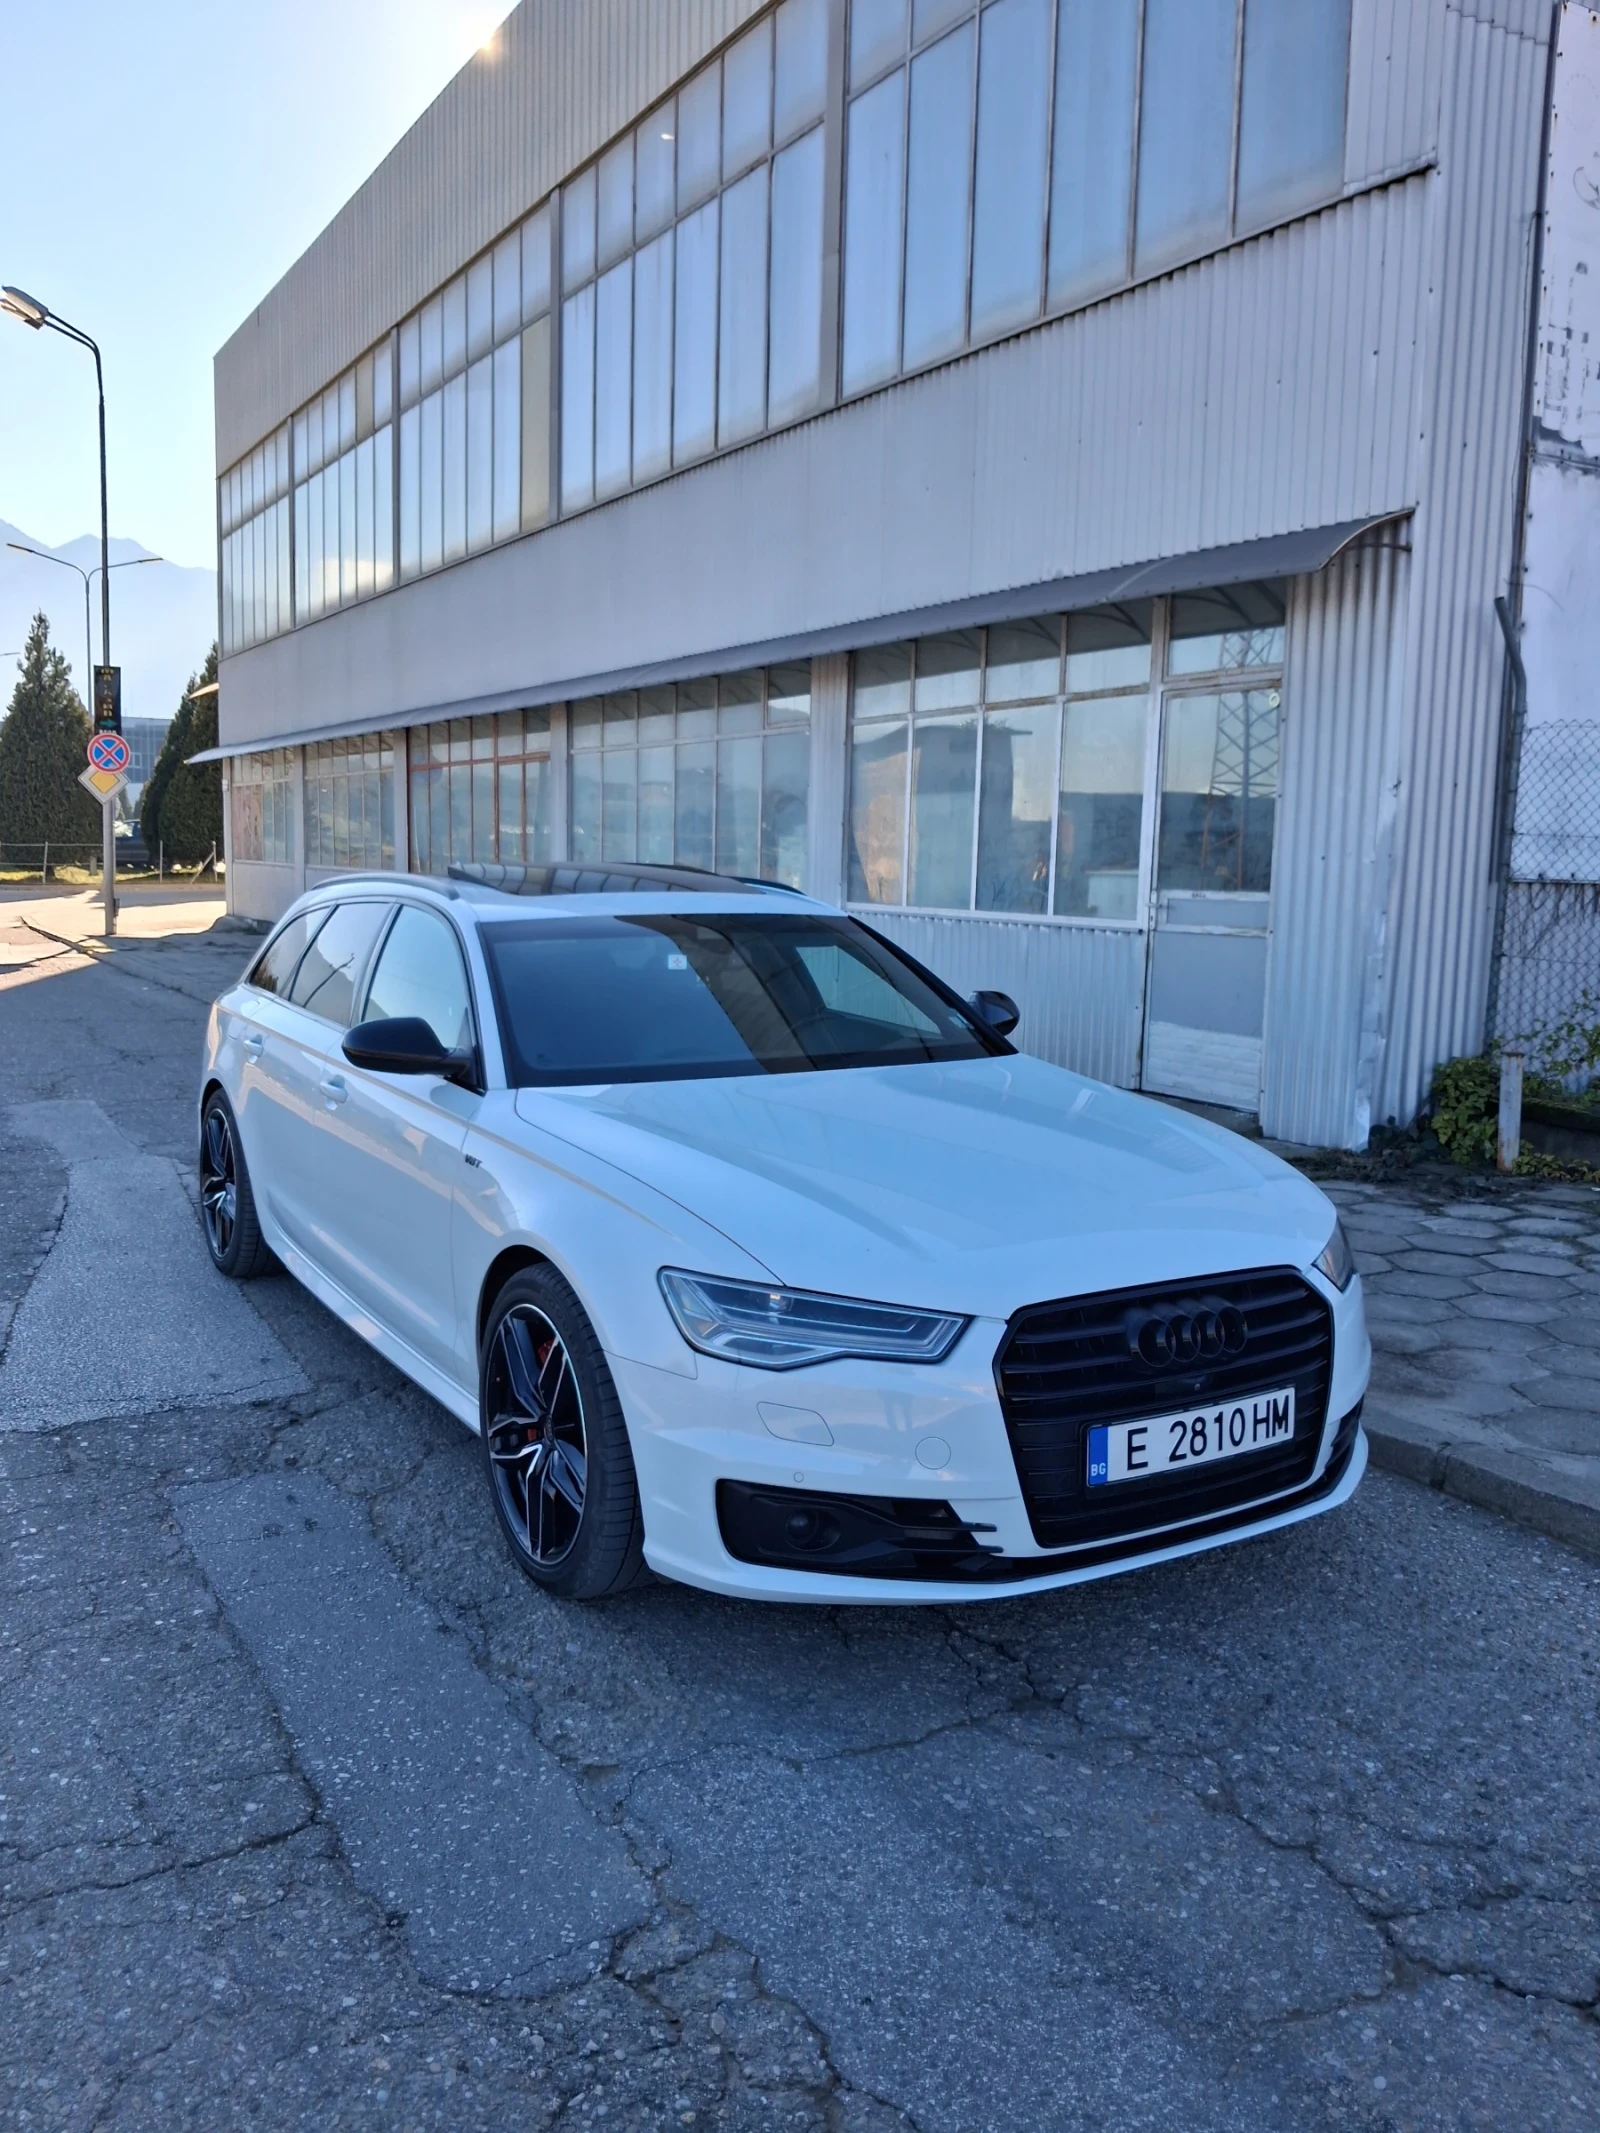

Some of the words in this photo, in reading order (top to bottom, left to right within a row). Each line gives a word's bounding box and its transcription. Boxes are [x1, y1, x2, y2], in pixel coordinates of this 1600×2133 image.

[1127, 1427, 1148, 1471] E
[1168, 1407, 1246, 1463] 2810
[1252, 1395, 1289, 1442] HM
[1090, 1462, 1106, 1476] BG
